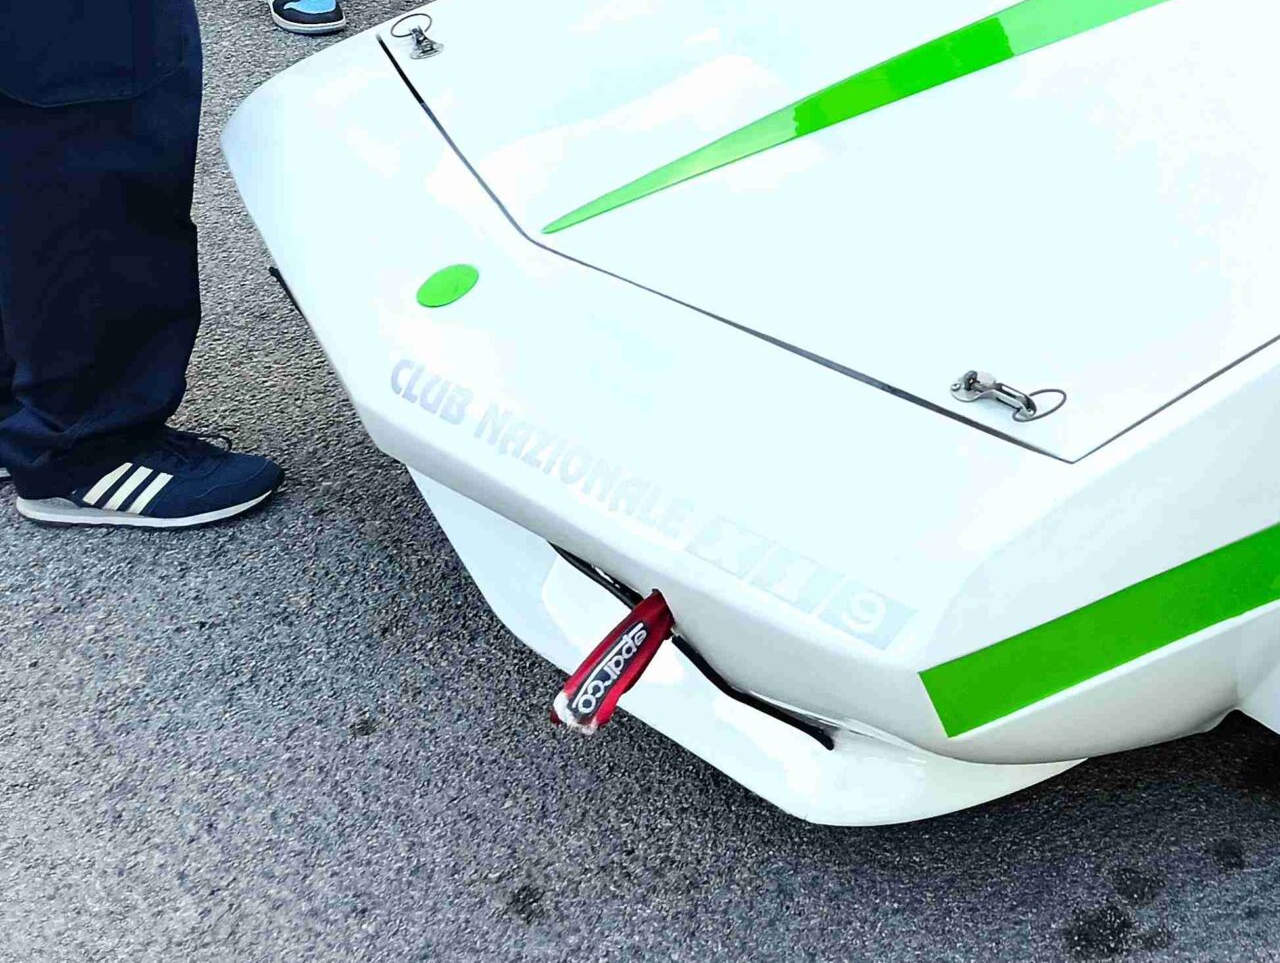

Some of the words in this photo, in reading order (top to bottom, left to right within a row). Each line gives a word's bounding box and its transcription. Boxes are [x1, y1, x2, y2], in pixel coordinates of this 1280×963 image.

[389, 358, 476, 426] CLUB
[473, 402, 695, 540] NAZIONALE
[571, 621, 648, 714] sparco
